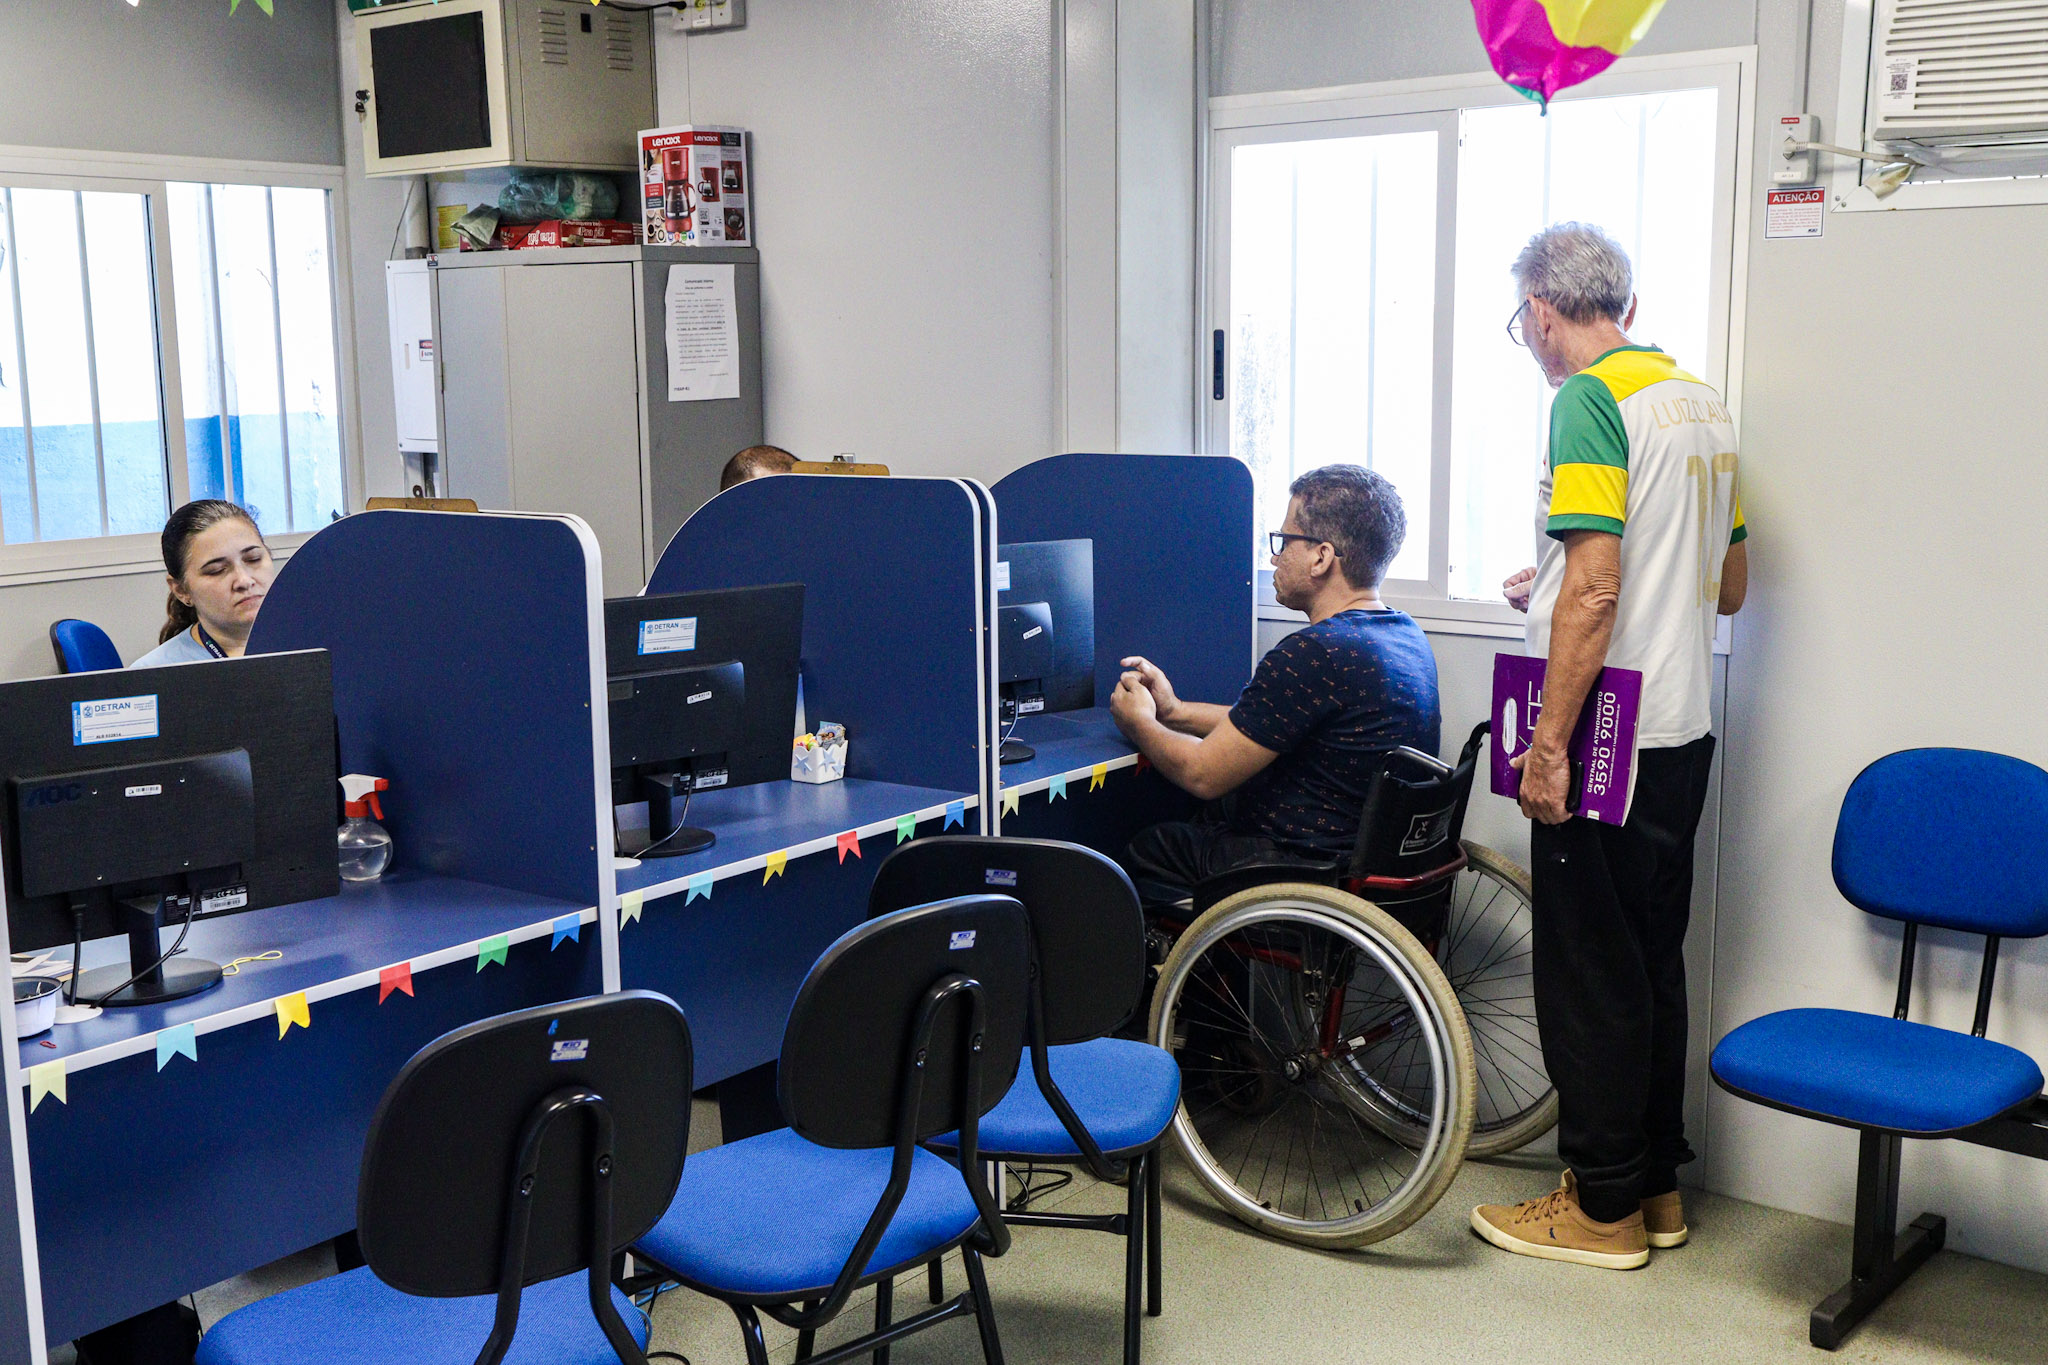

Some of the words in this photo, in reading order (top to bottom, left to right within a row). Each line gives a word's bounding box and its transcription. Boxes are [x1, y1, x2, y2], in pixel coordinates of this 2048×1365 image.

[1772, 192, 1820, 204] ATENÇÃO
[654, 622, 679, 630] DETRAN
[94, 702, 131, 712] DETRAN
[1600, 692, 1616, 740] 9000
[1587, 758, 1597, 793] CENTRAL
[1592, 747, 1598, 757] DE
[1595, 691, 1603, 745] ATENDIMENTO
[1593, 748, 1611, 796] 3590
